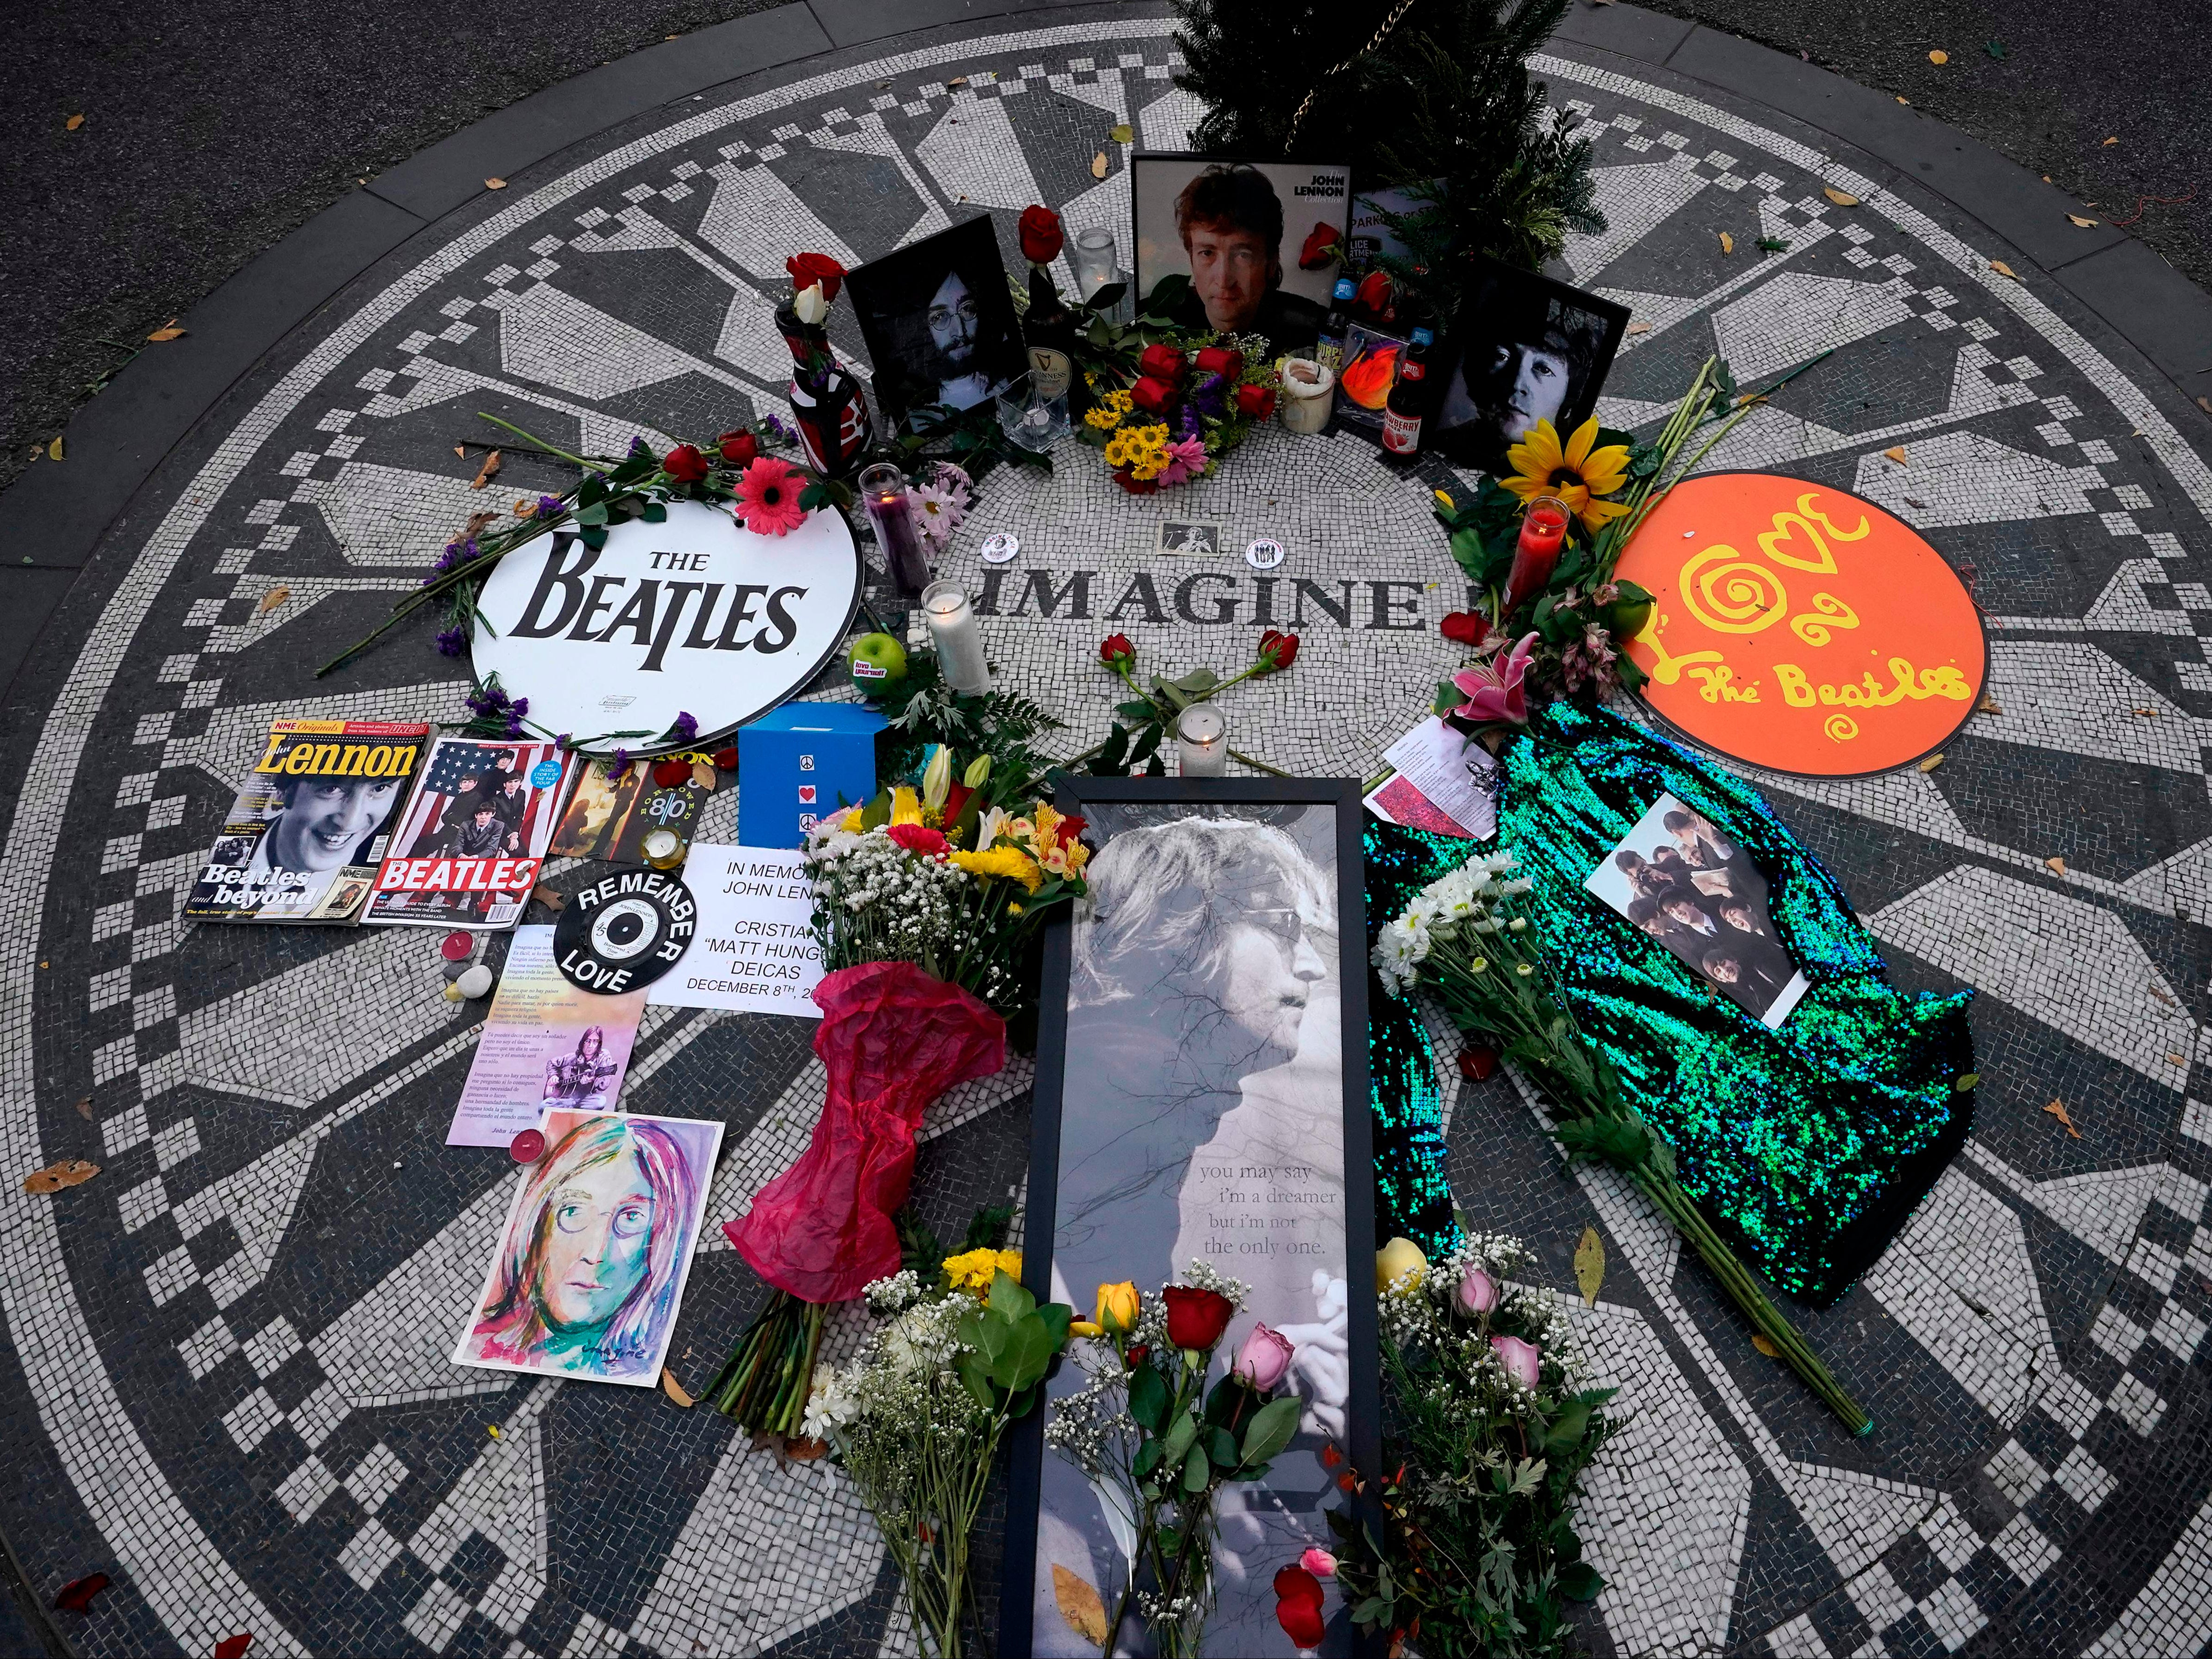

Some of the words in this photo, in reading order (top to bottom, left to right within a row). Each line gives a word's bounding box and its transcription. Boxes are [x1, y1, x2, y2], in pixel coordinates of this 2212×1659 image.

[1311, 175, 1344, 186] JOHN
[1295, 186, 1344, 196] LENNON
[1305, 194, 1343, 203] Collection
[985, 535, 1006, 547] IMAGINE
[649, 551, 711, 571] THE
[507, 531, 810, 672] BEATLES
[971, 567, 1426, 631] IMAGINE
[1687, 666, 1762, 704] The
[1772, 657, 1971, 708] Beatles
[297, 721, 339, 732] Originals
[389, 725, 428, 734] UNCUT
[253, 734, 417, 777] Lennon
[260, 743, 290, 759] John
[201, 864, 312, 886] Beatles
[339, 869, 361, 878] NME
[379, 860, 536, 890] BEATLES
[727, 862, 745, 875] IN
[750, 864, 808, 880] MEMO
[191, 894, 213, 903] and
[212, 884, 318, 909] beyond
[723, 882, 773, 897] JOHN
[577, 873, 694, 961] REMEMBER
[632, 908, 654, 918] LENNON
[596, 922, 606, 936] 45
[735, 921, 810, 940] CRISTIA
[604, 942, 626, 952] Borrowed
[560, 949, 633, 993] LOVE
[731, 961, 801, 980] DEICAS
[687, 978, 769, 996] DECEMBER
[1200, 1166, 1233, 1183] you
[1240, 1167, 1277, 1184] may
[1284, 1166, 1312, 1184] say
[1219, 1188, 1245, 1203] i'm
[1252, 1192, 1260, 1203] a
[1266, 1188, 1337, 1203] dreamer
[1209, 1213, 1235, 1228] but
[1240, 1214, 1264, 1228] i'm
[1269, 1217, 1296, 1228] not
[1205, 1236, 1233, 1254] the
[1239, 1237, 1280, 1259] only
[1287, 1242, 1326, 1254] one.
